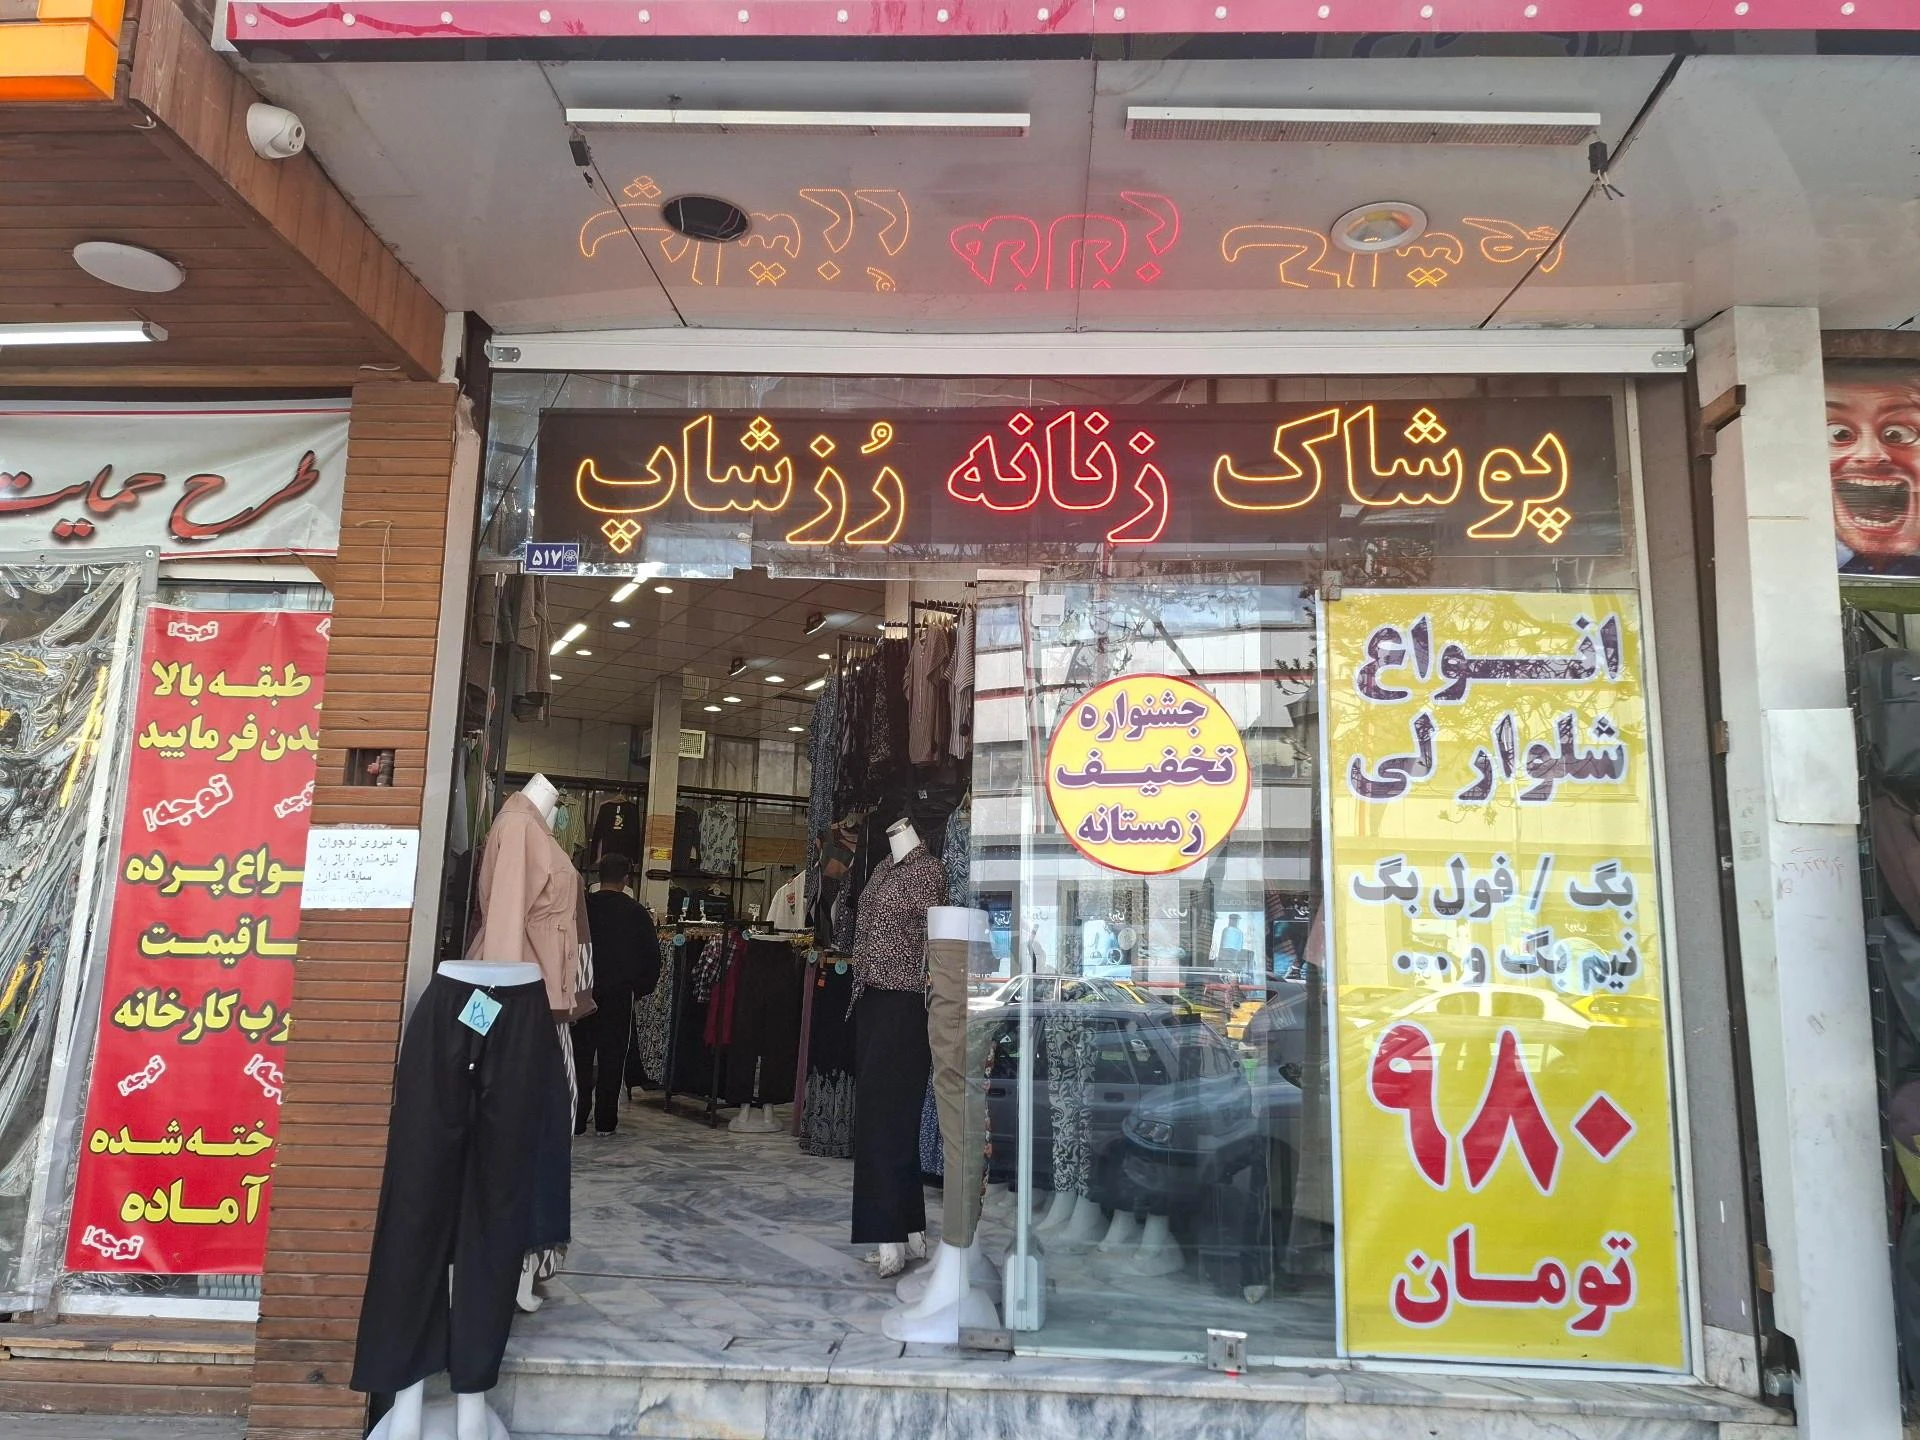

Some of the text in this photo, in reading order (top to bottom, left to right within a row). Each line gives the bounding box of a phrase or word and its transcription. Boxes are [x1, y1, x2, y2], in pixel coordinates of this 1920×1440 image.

[167, 449, 320, 545] طرح
[946, 409, 1170, 545] زنانه
[1212, 405, 1573, 545] پوشاک
[531, 549, 562, 567] ۵۱۷
[150, 659, 312, 707] طبقه بالا
[1355, 613, 1625, 704] انواع
[138, 713, 259, 762] فرمایید
[1078, 689, 1208, 742] جشنواره
[1055, 745, 1238, 797] تخفیف
[1348, 710, 1628, 805] شلوار لی
[318, 836, 357, 849] نوجوان
[1075, 803, 1206, 856] زمستانه
[125, 846, 305, 896] واع پرده
[1351, 856, 1421, 917] بگ
[1432, 853, 1516, 921] فول
[1566, 859, 1637, 922] بگ
[141, 916, 251, 965] قیمت
[1580, 931, 1638, 992] نیم
[114, 990, 290, 1042] رب کارخانه
[1370, 1020, 1637, 1197] ۹۸۰
[89, 1119, 184, 1155] شده
[120, 1174, 272, 1225] آماده
[1391, 1223, 1637, 1335] تومان
